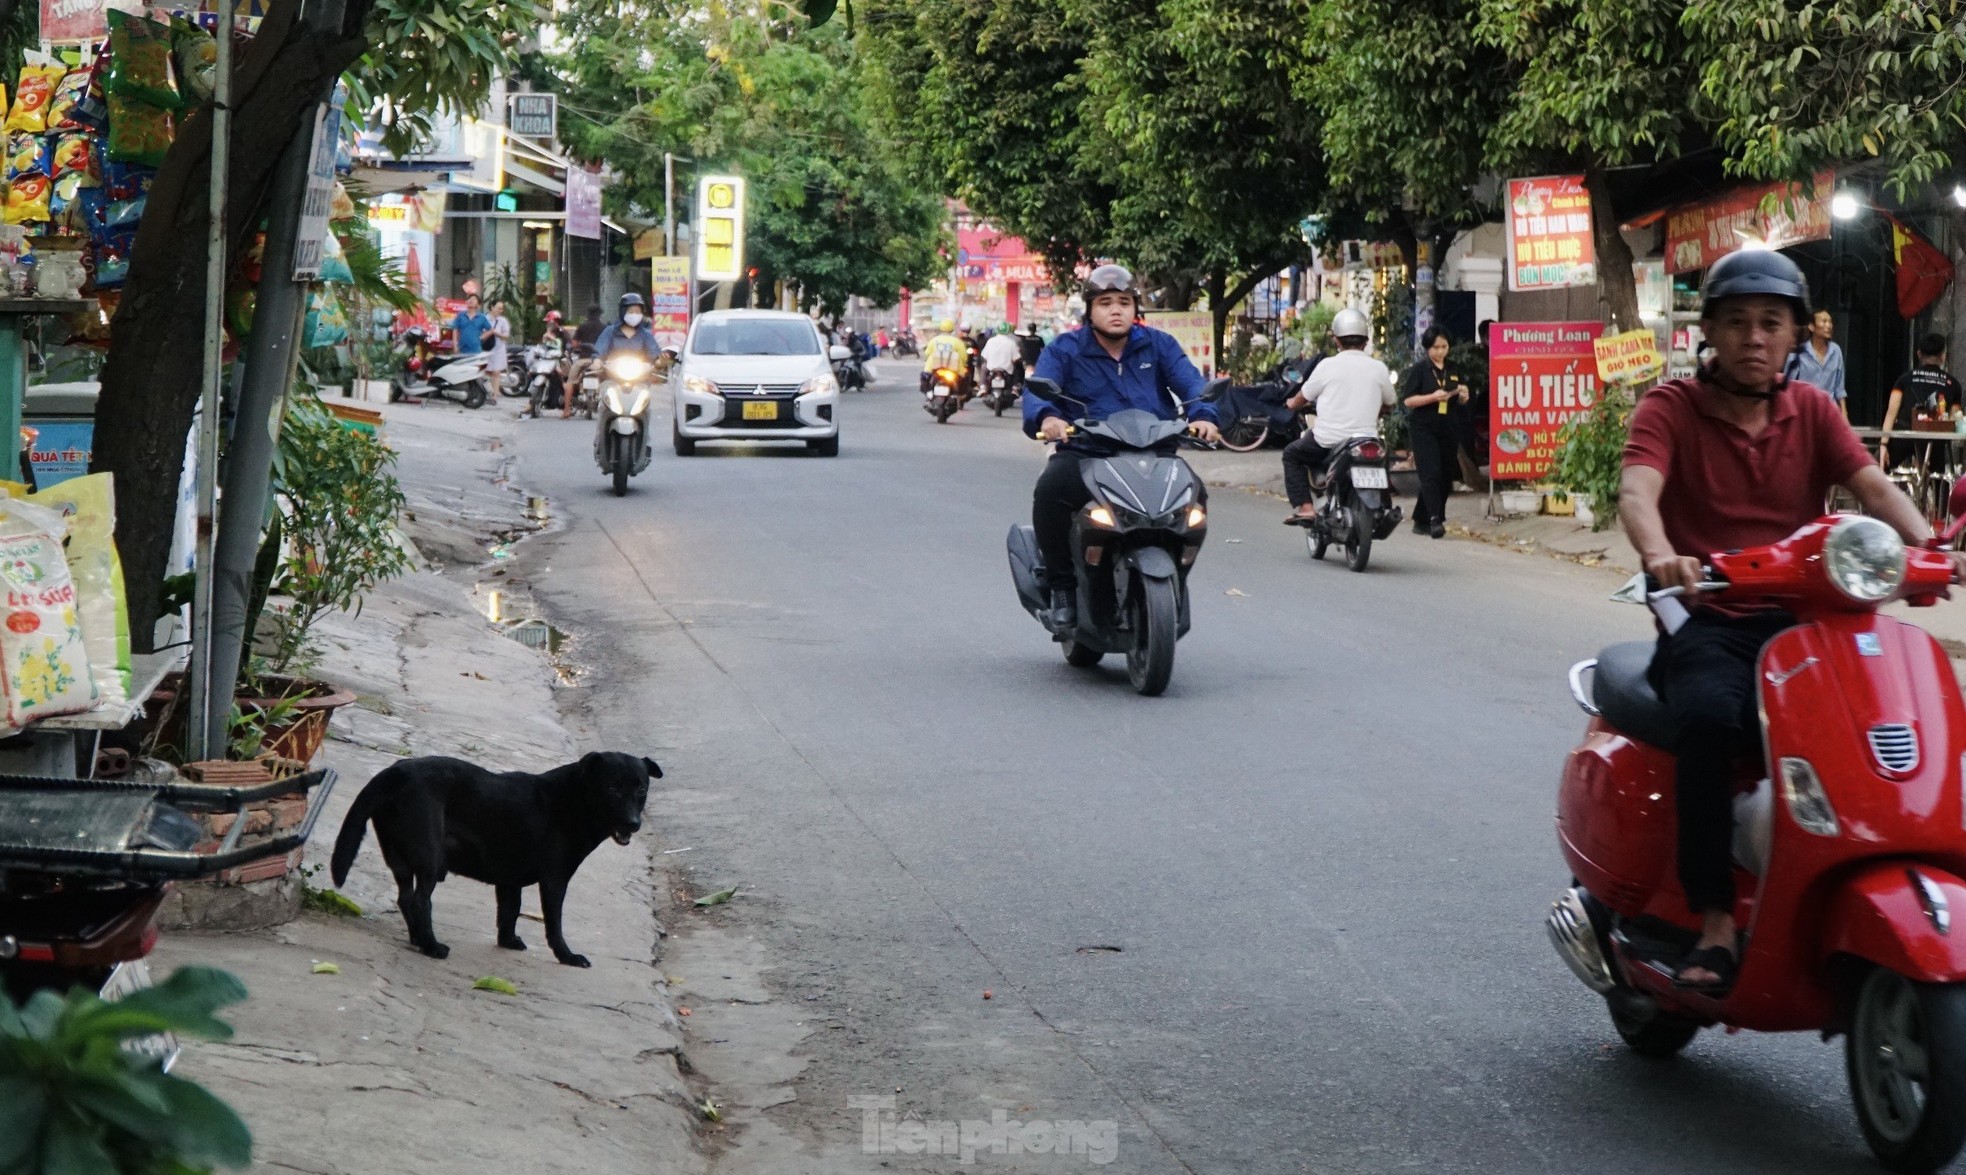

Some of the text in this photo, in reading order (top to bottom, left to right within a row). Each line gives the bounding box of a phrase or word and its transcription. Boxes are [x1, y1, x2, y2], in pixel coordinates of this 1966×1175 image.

[515, 116, 551, 133] KHOA
[1503, 328, 1591, 344] Phương Loan
[1628, 355, 1651, 367] HEO
[1497, 359, 1595, 409] HỦ TIẾU
[1501, 412, 1540, 426] NAM
[61, 445, 84, 463] TẾT
[1497, 462, 1531, 473] BÁNH
